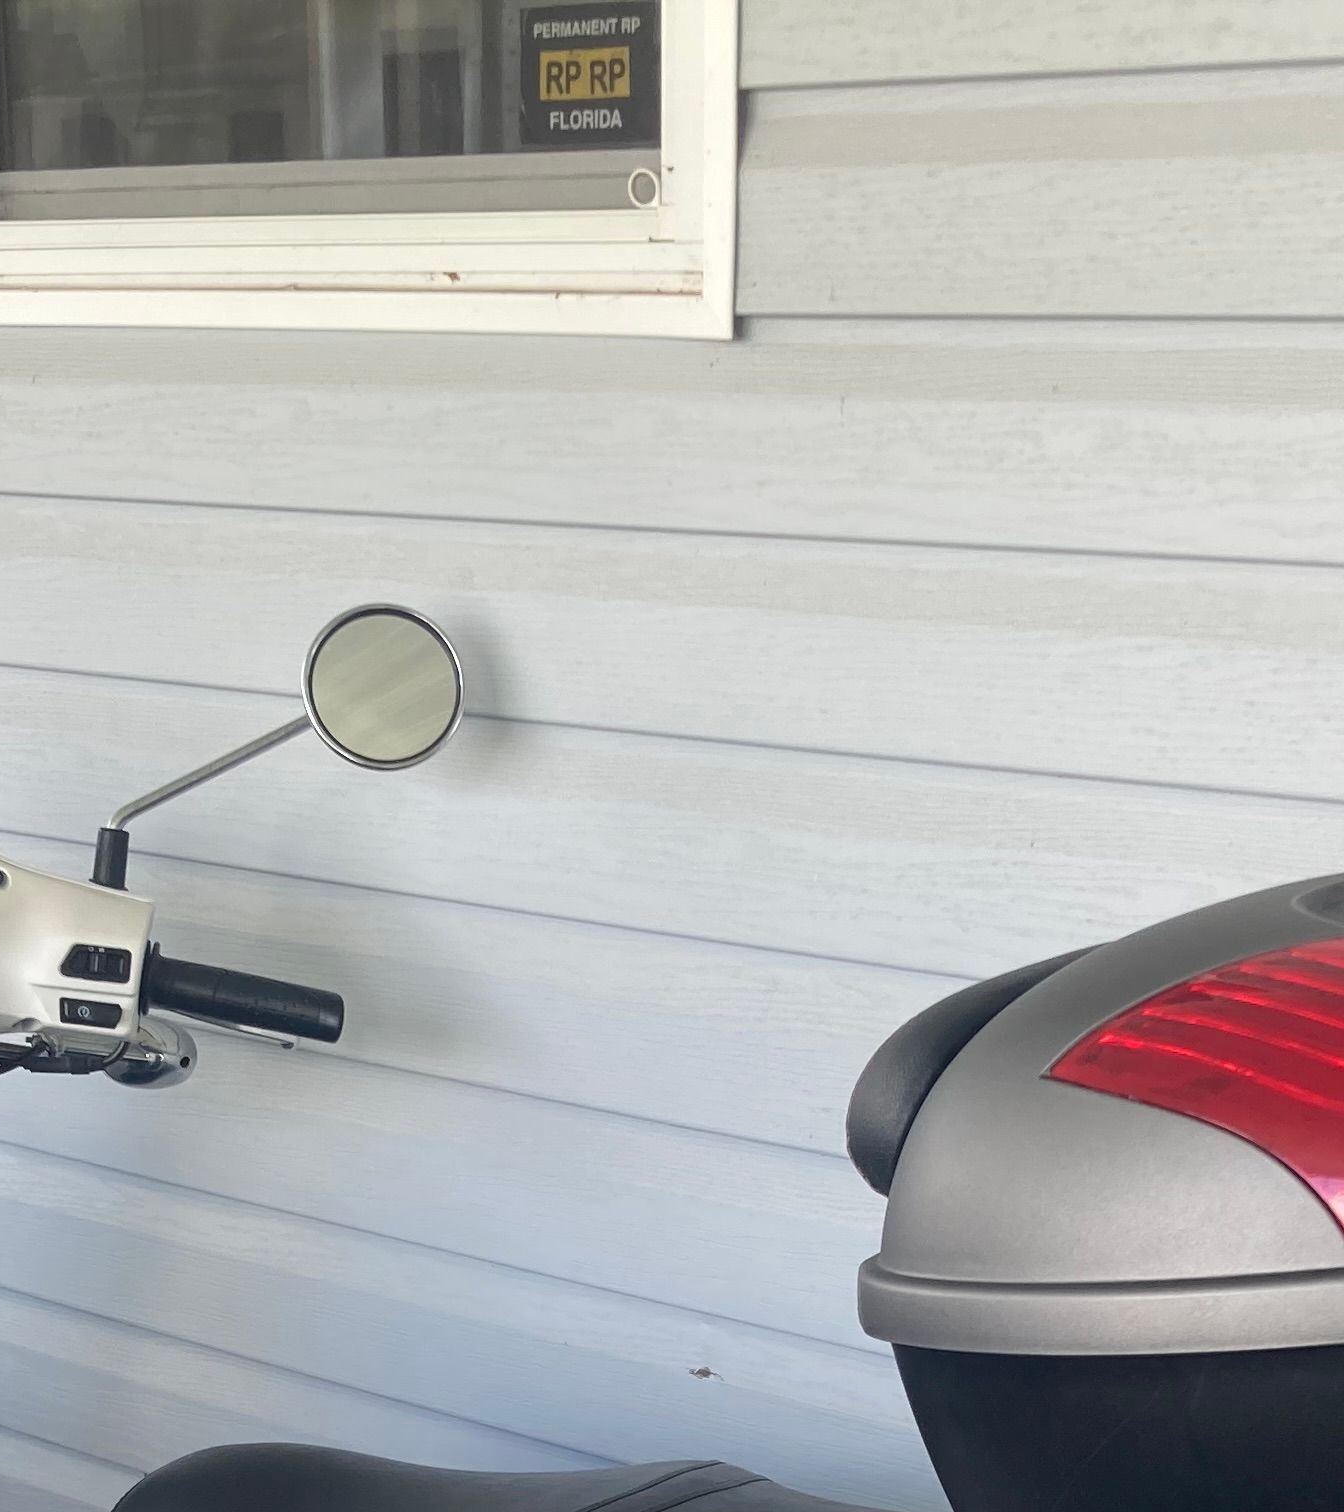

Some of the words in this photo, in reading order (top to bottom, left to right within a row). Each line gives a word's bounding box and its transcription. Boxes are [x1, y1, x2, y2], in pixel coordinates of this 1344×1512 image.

[534, 18, 617, 39] PERMANENT
[622, 17, 640, 34] RP
[546, 61, 581, 94] RP
[590, 58, 625, 94] RP
[550, 109, 623, 130] FLORIDA
